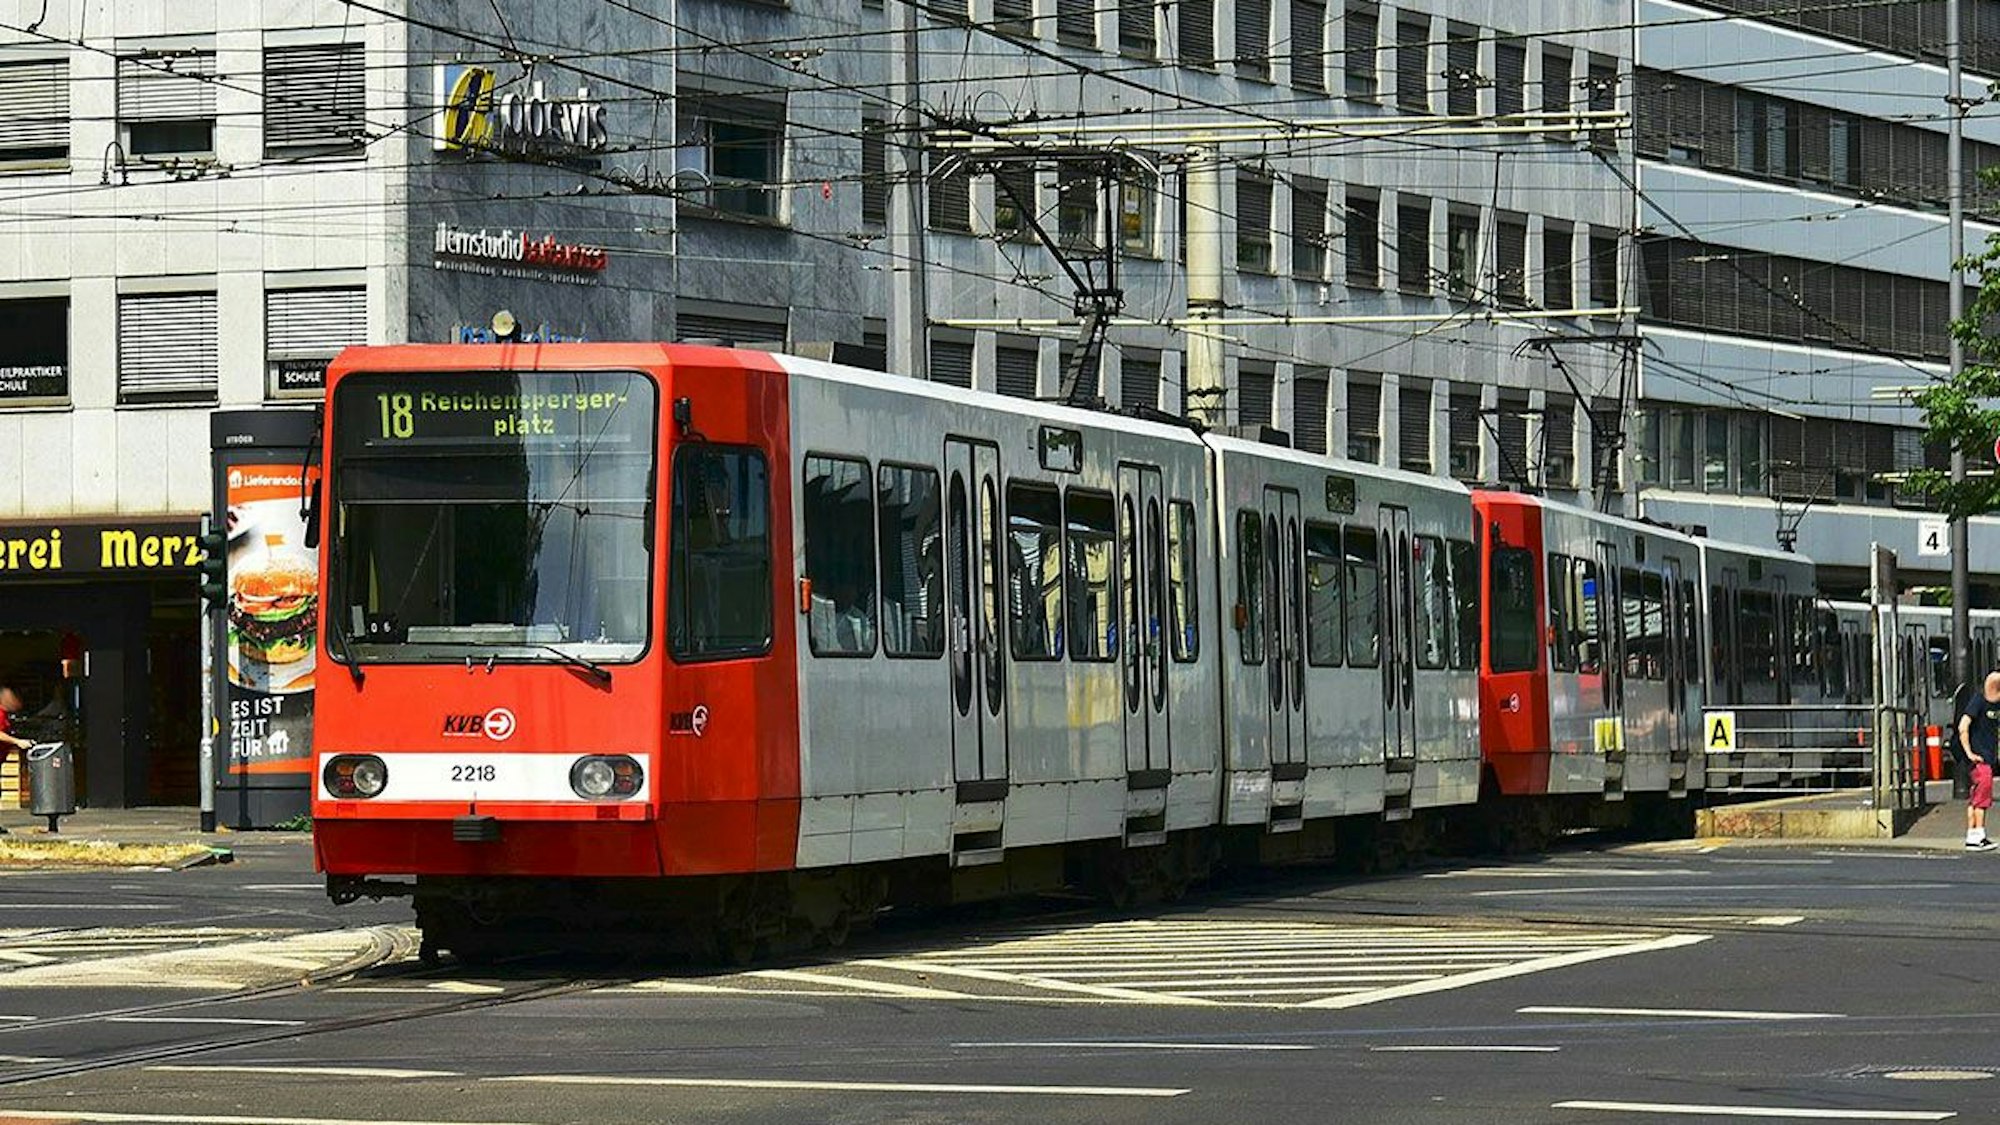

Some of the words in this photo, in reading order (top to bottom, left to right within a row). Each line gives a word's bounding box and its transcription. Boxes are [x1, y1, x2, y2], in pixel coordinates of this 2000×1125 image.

[0, 366, 63, 379] EILPRAKTIKER
[284, 371, 321, 383] SCHULE
[420, 391, 628, 412] Reichensperger-
[377, 393, 415, 438] 18
[494, 414, 554, 437] platz
[0, 528, 62, 569] rei
[101, 530, 202, 567] Merz
[1926, 531, 1940, 550] 4
[231, 700, 249, 719] ES
[254, 696, 284, 716] IST
[231, 719, 267, 739] ZEIT
[444, 715, 484, 733] KVB
[1710, 718, 1729, 746] A
[231, 737, 263, 758] FÜR
[451, 764, 496, 781] 2218
